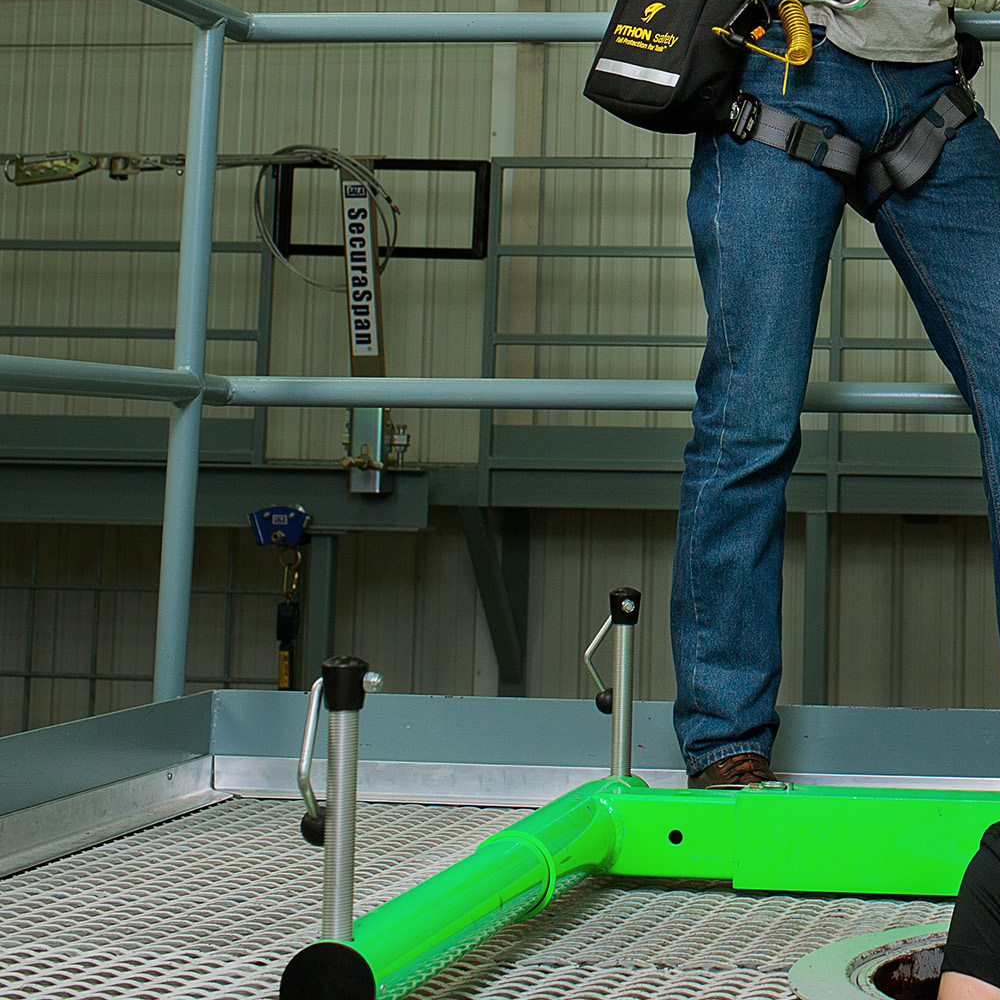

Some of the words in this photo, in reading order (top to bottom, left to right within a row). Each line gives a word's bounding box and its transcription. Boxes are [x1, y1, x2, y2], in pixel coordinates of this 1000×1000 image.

[613, 24, 652, 41] PYTHON
[653, 32, 679, 48] safety
[623, 38, 648, 50] Protection
[347, 207, 373, 345] SecuraSpan
